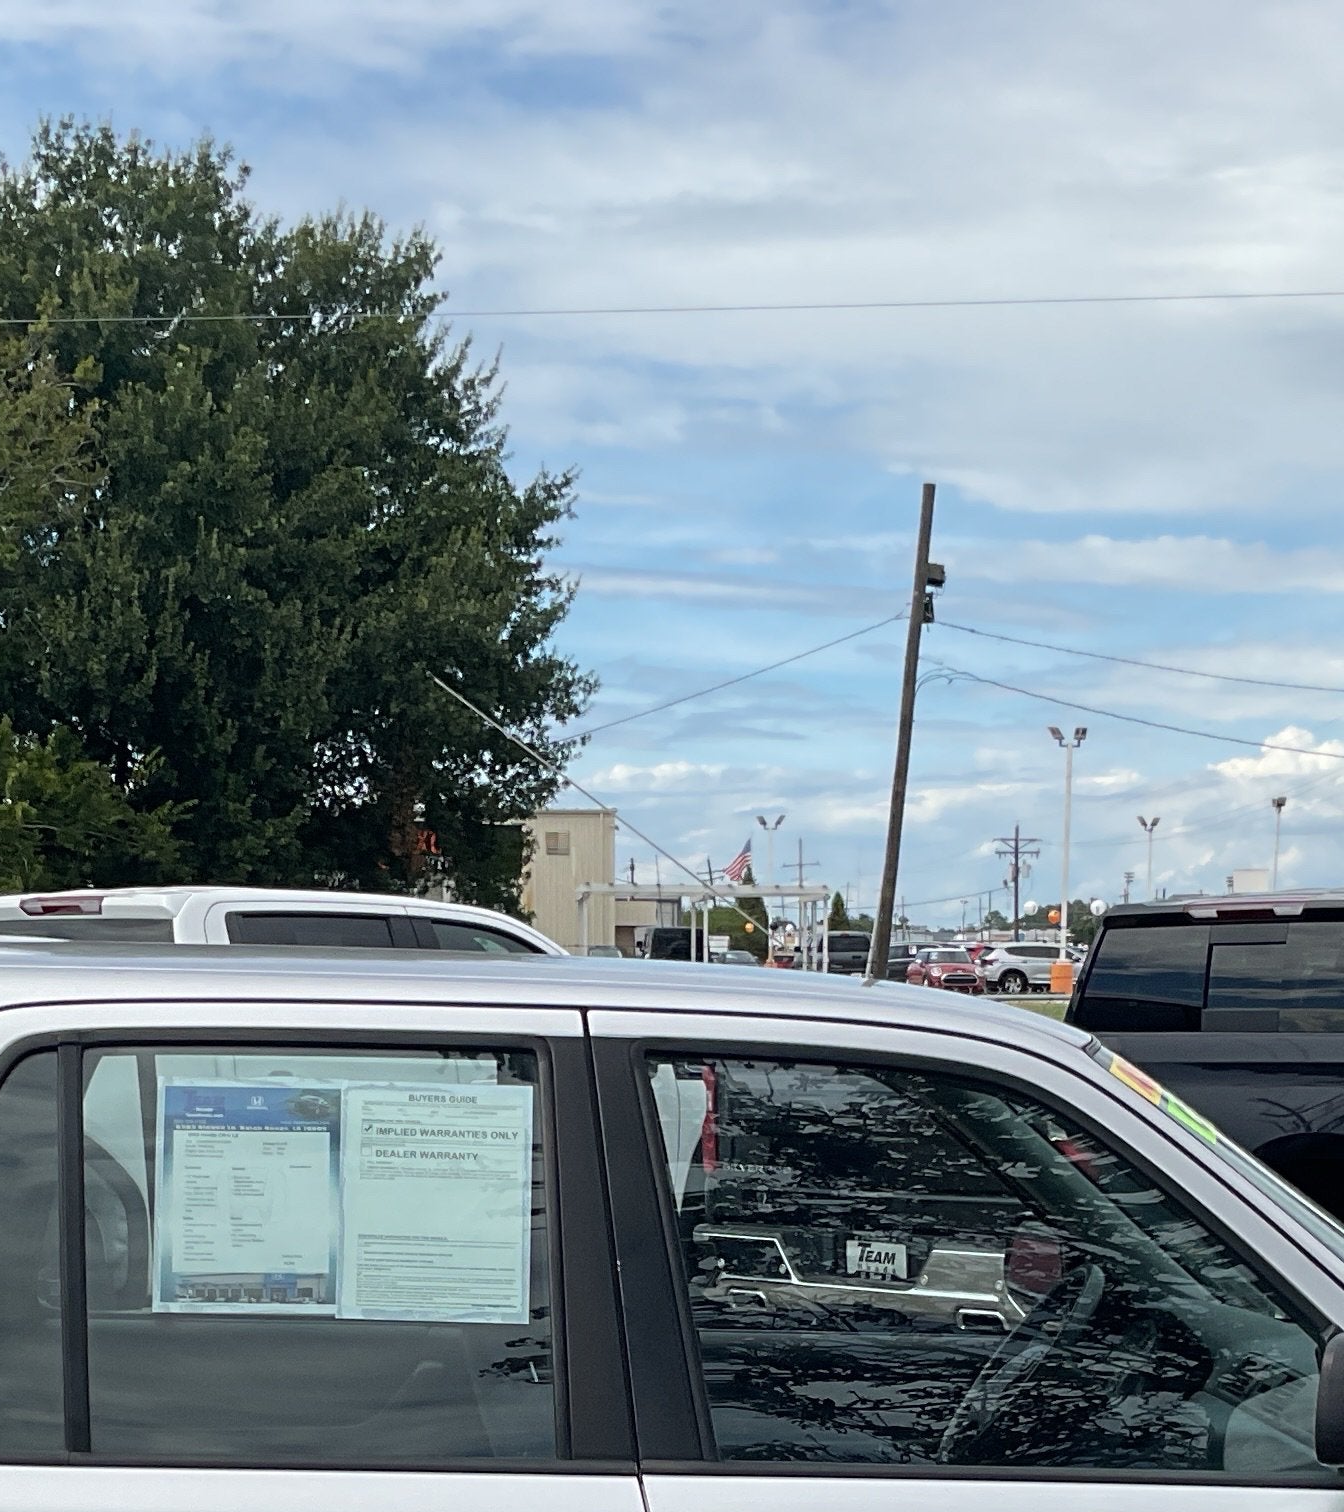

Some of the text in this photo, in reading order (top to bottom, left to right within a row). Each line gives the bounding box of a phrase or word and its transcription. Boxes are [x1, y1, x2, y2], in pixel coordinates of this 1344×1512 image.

[409, 1094, 478, 1104] BUYERS GUIDE
[376, 1127, 518, 1140] IMPLIED WARRANTIES ONLY
[376, 1149, 478, 1160] DEALER WARRANTY
[857, 1242, 896, 1265] TEAM
